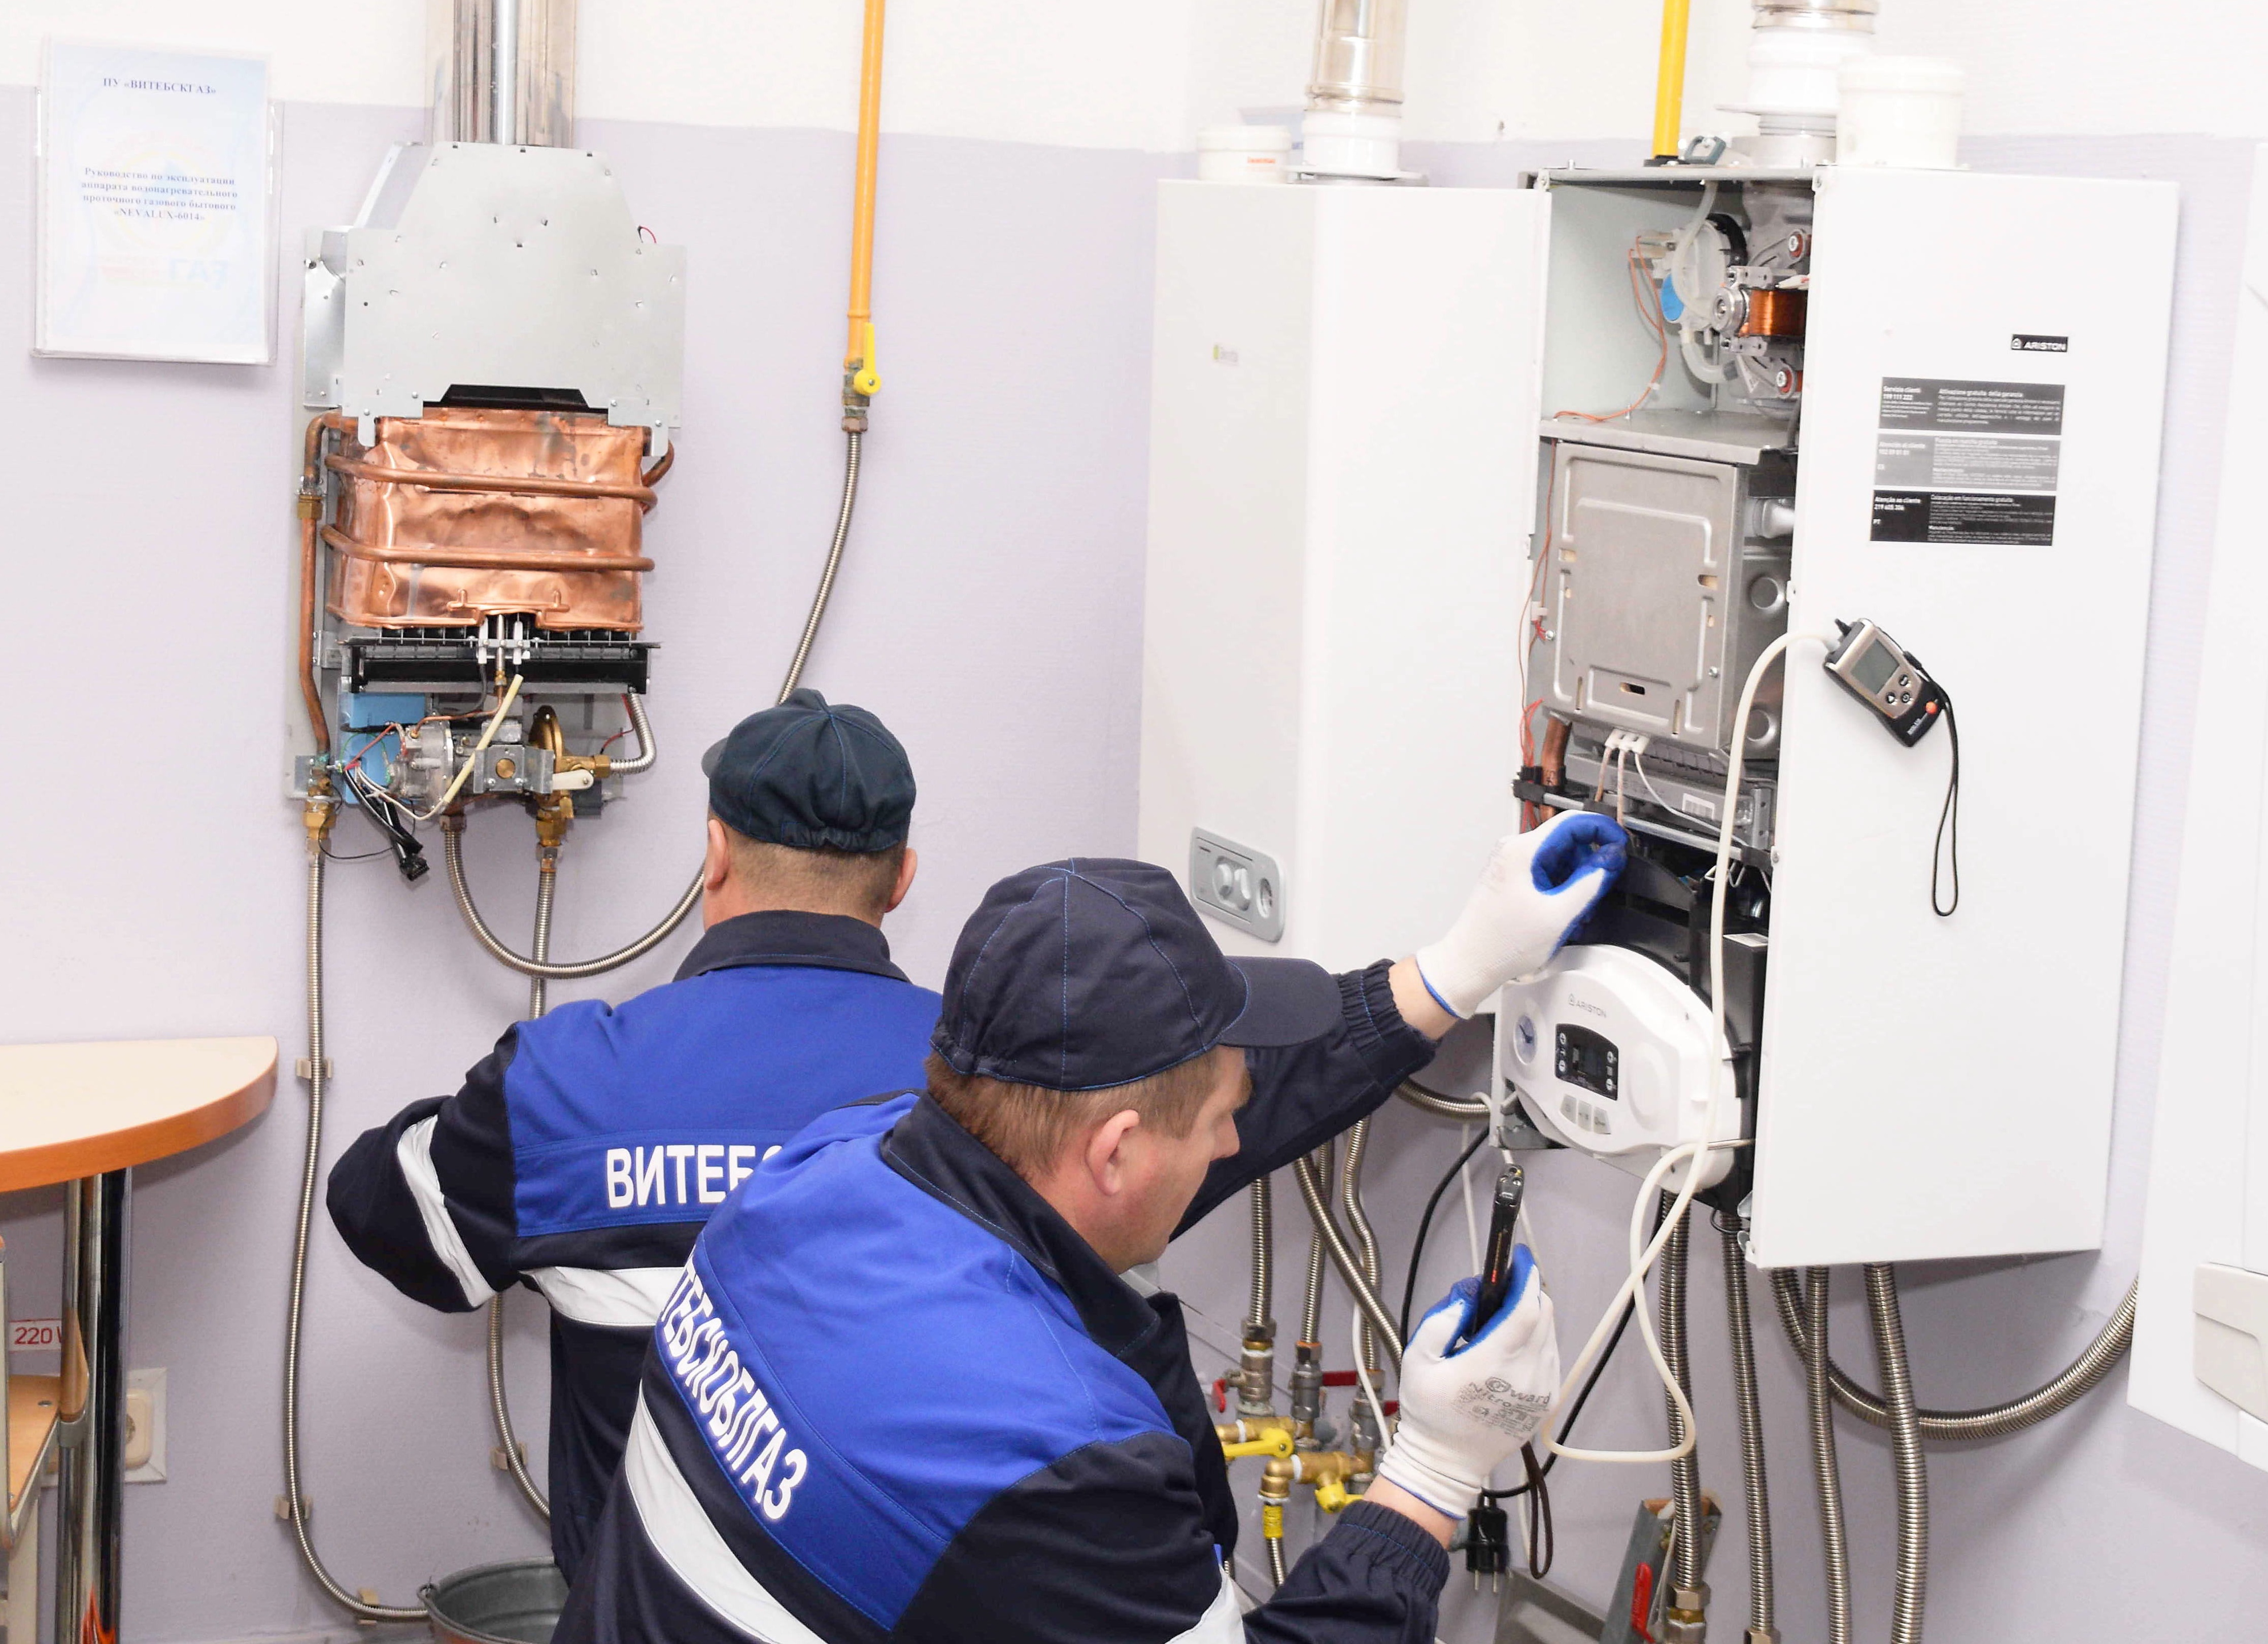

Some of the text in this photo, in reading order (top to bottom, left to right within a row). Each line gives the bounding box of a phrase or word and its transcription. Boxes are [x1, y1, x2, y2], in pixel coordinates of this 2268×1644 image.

[104, 78, 216, 94] ПУ «ВИТЕБСКГАЗ»
[85, 167, 148, 179] Руководство
[167, 175, 234, 185] эксплуатации
[81, 182, 238, 198] аппарата водонагревательного
[83, 195, 236, 211] проточного газового бытового
[2023, 341, 2067, 351] ARISTON
[606, 1144, 783, 1208] ВИТЕБ
[661, 1244, 807, 1520] ТЕБСКОБЛГАЗ
